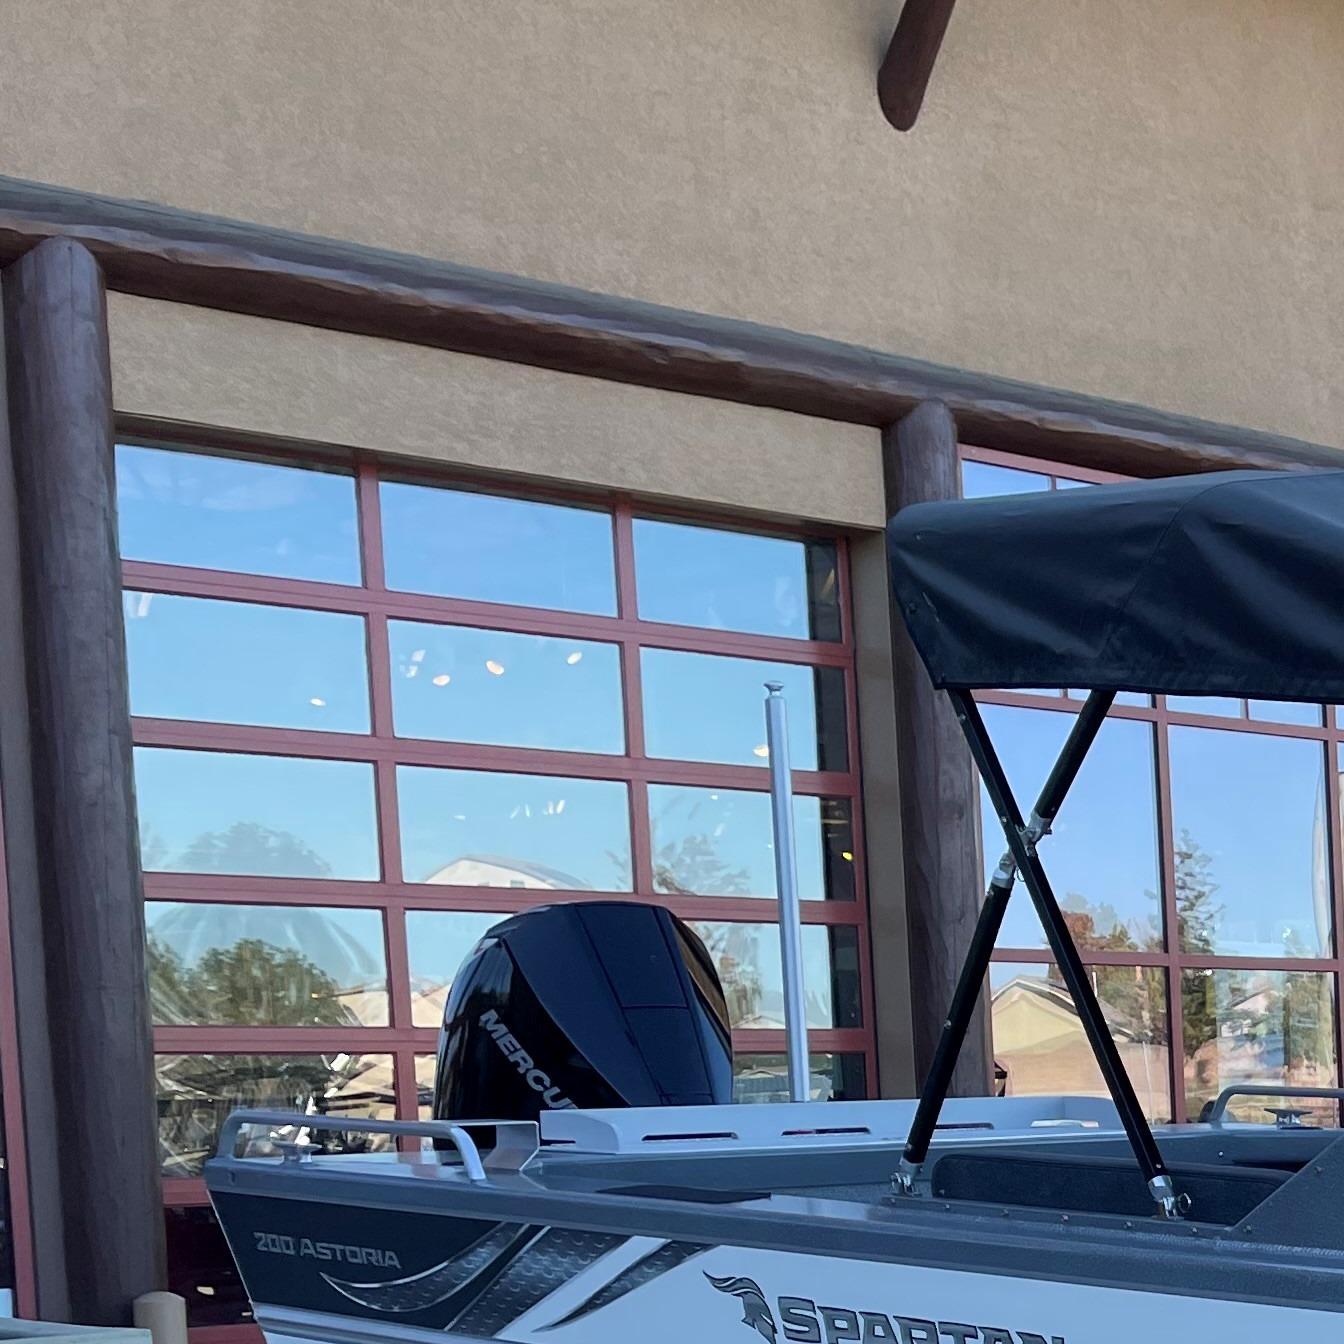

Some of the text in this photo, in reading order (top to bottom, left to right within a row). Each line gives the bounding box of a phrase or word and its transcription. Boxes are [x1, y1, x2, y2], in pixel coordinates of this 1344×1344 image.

[479, 1008, 578, 1110] MERCU
[252, 1231, 402, 1269] 200 ASTORIA
